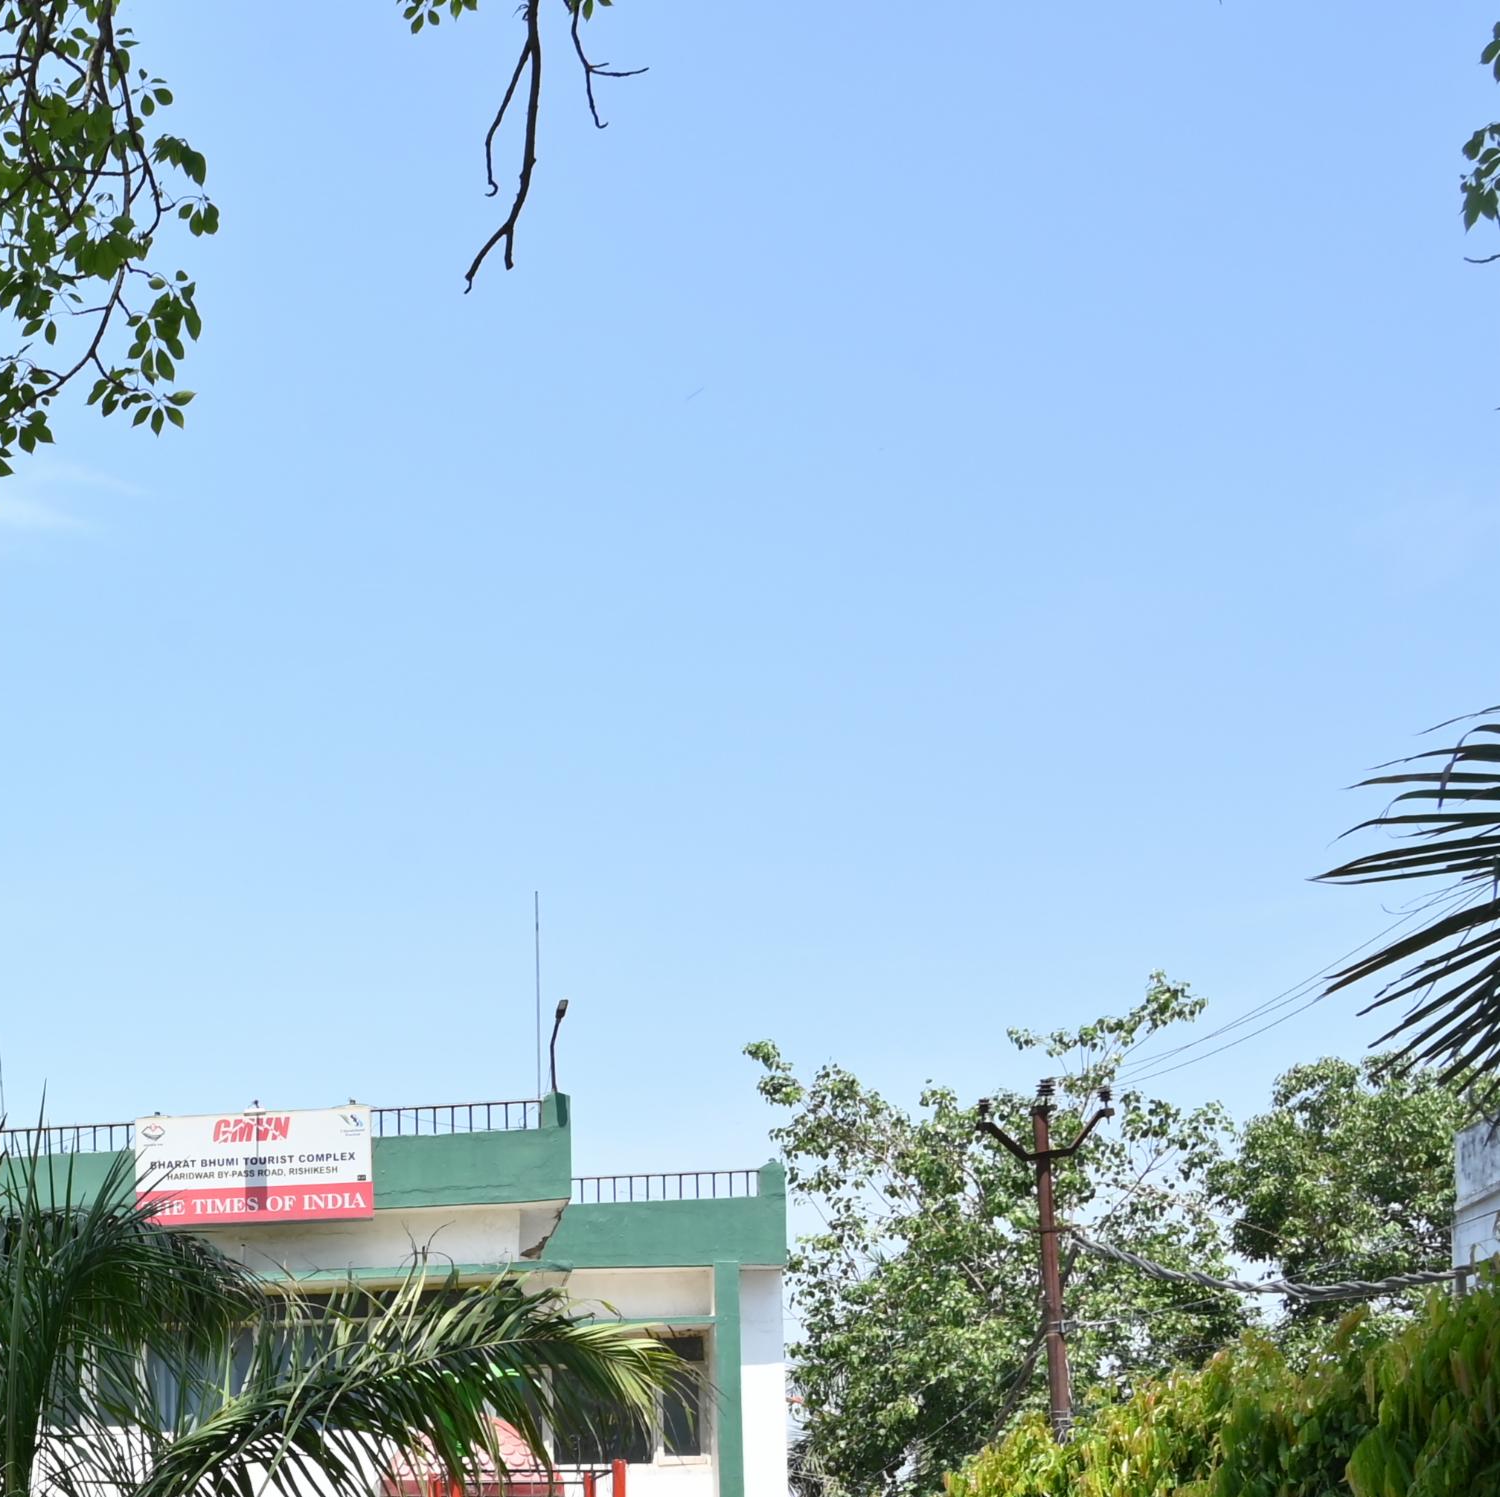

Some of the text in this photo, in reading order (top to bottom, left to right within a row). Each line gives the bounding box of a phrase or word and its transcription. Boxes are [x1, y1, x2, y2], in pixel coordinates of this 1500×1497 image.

[213, 1116, 290, 1144] GMVN
[150, 1152, 356, 1170] BHARAT BHUMI TOURIST COMPLEX
[167, 1166, 338, 1181] HARIDWAR BY-PASS ROAD, RISHIKESH
[192, 1197, 259, 1215] TIMES
[266, 1195, 297, 1212] OF
[303, 1192, 367, 1211] INDIA
